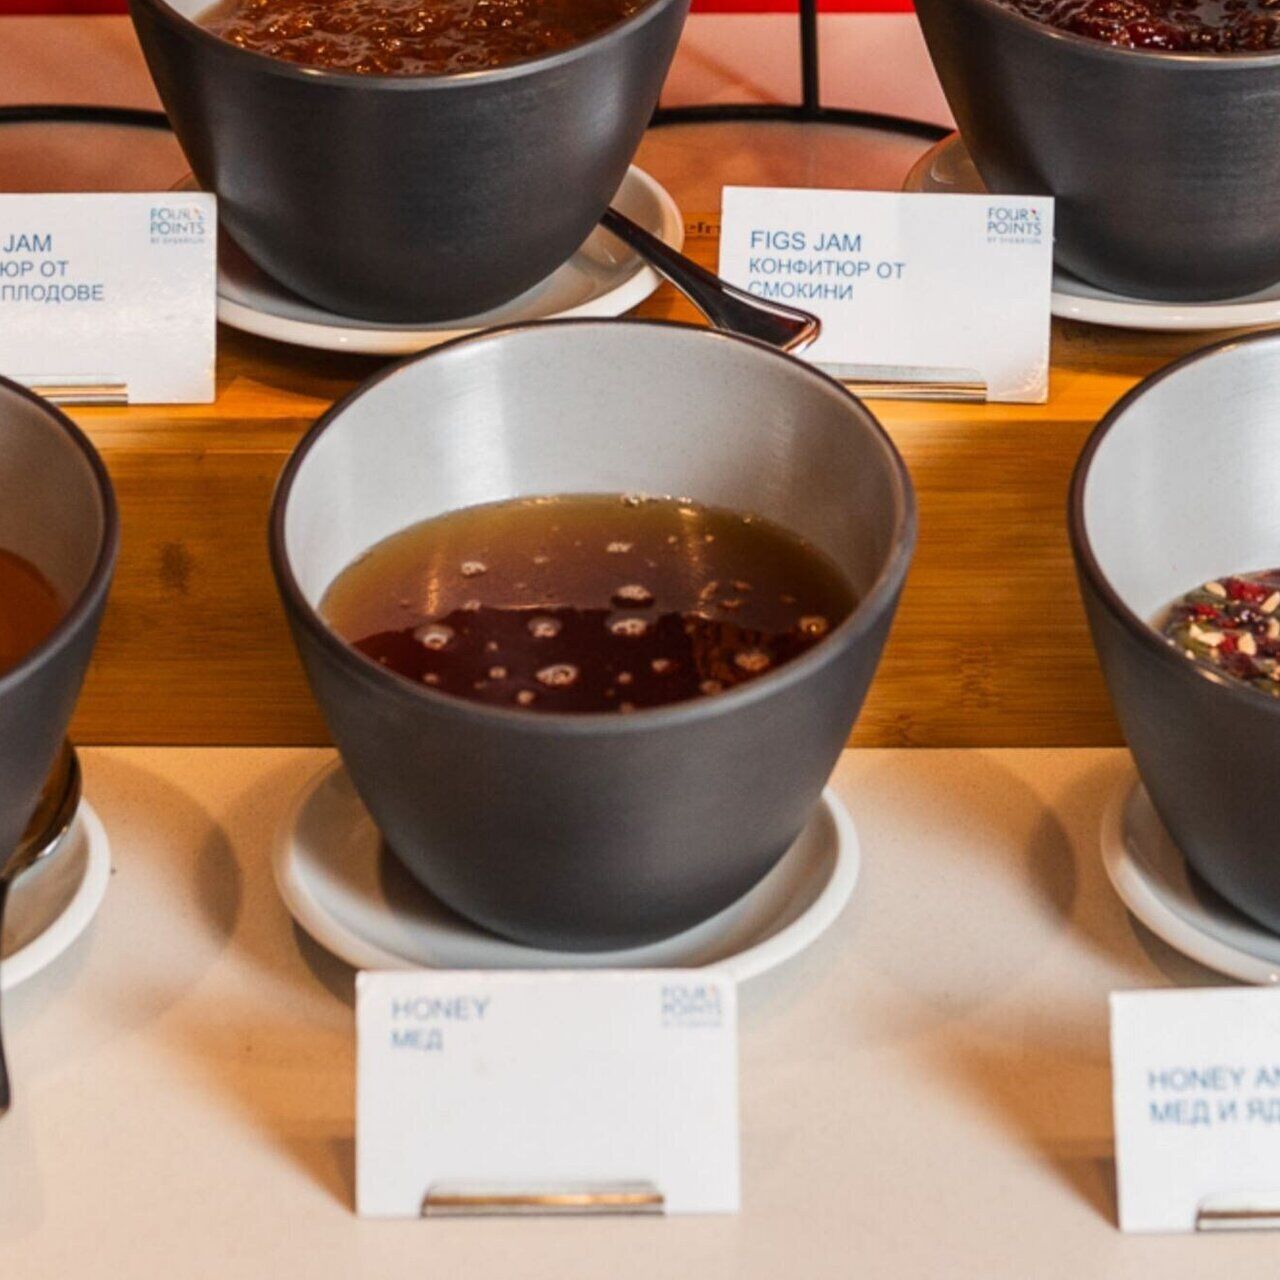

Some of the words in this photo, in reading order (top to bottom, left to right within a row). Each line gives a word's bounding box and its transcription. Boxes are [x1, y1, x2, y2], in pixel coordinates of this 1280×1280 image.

[987, 207, 1029, 220] FOUR
[150, 221, 205, 235] POINTS
[987, 221, 1042, 235] POINTS
[3, 234, 52, 252] JAM
[750, 230, 805, 251] FIGS
[813, 233, 862, 252] JAM
[40, 261, 69, 276] ОТ
[749, 257, 870, 278] КОНФИТЮР
[876, 261, 906, 279] ОТ
[2, 284, 104, 304] ПЛОДОВЕ
[748, 281, 853, 300] СМОКИНИ
[391, 996, 491, 1021] HONEY
[390, 1029, 444, 1051] МЕД
[1148, 1065, 1245, 1092] HONEY
[1148, 1100, 1211, 1125] МЕД
[1219, 1100, 1237, 1121] И
